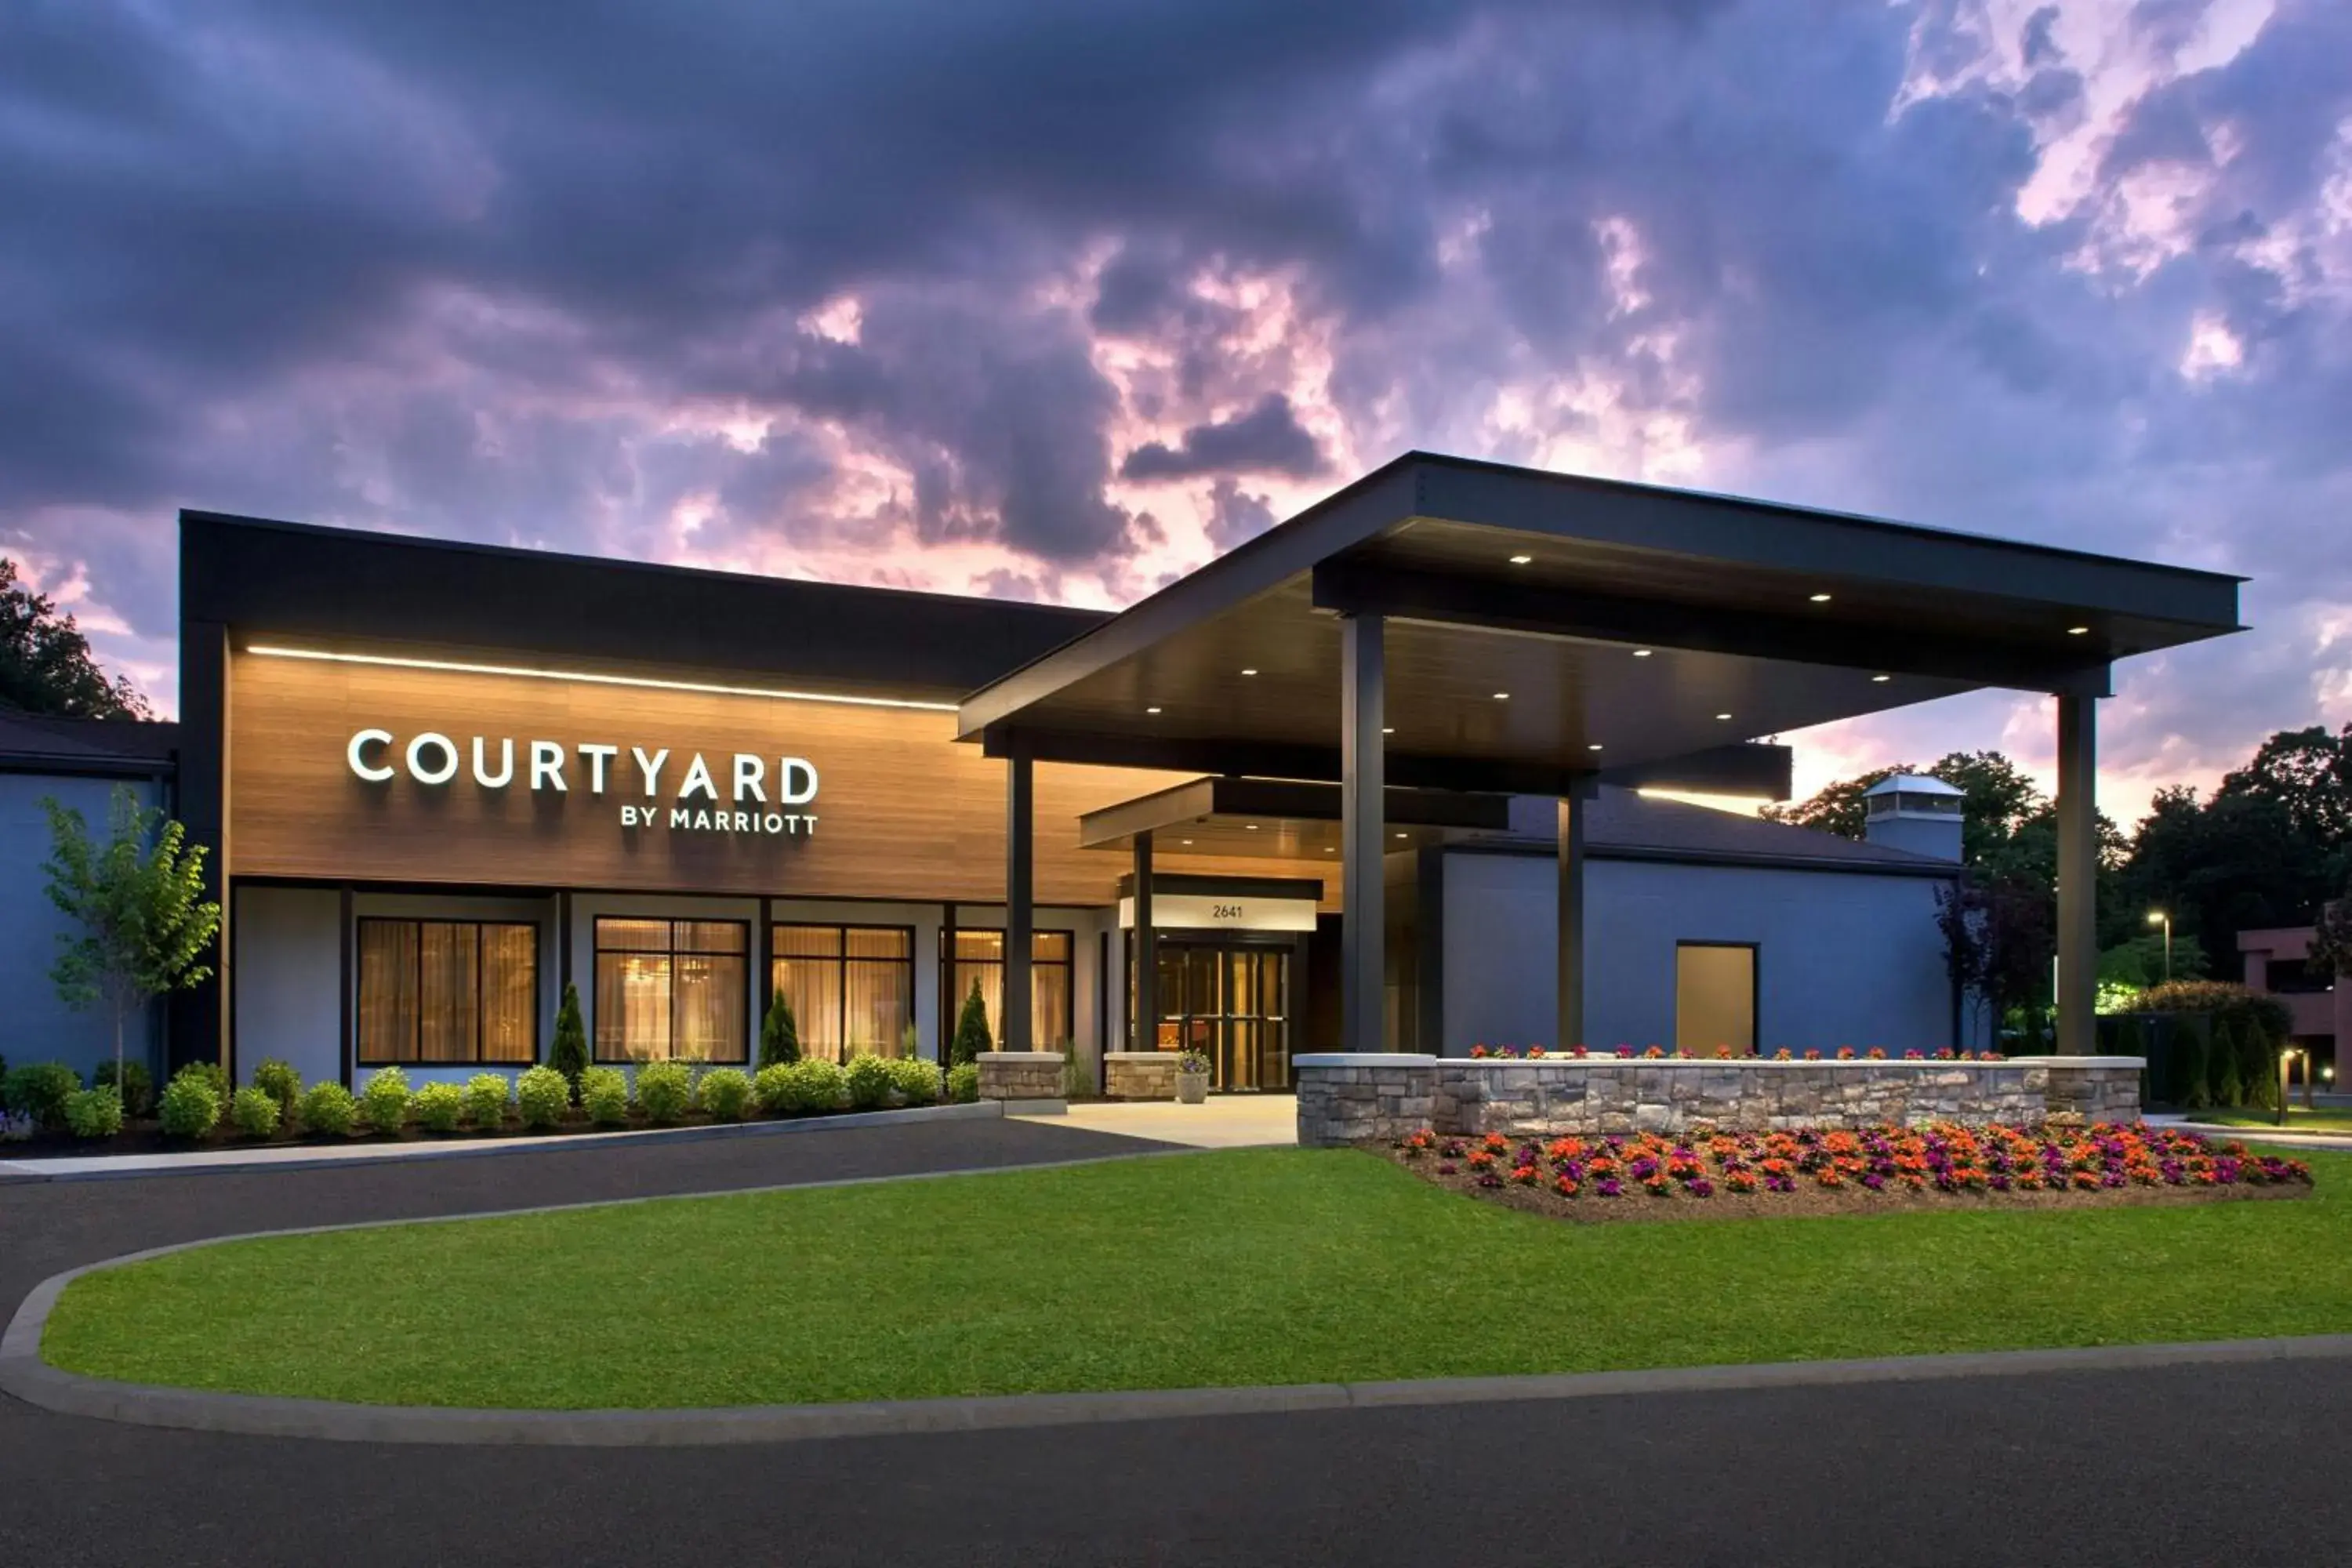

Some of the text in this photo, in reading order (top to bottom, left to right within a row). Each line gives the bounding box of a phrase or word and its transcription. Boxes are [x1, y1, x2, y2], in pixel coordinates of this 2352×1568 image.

[347, 728, 819, 804] COURTYARD
[620, 806, 818, 835] BY MARRIOTT
[1213, 906, 1242, 918] 2641
